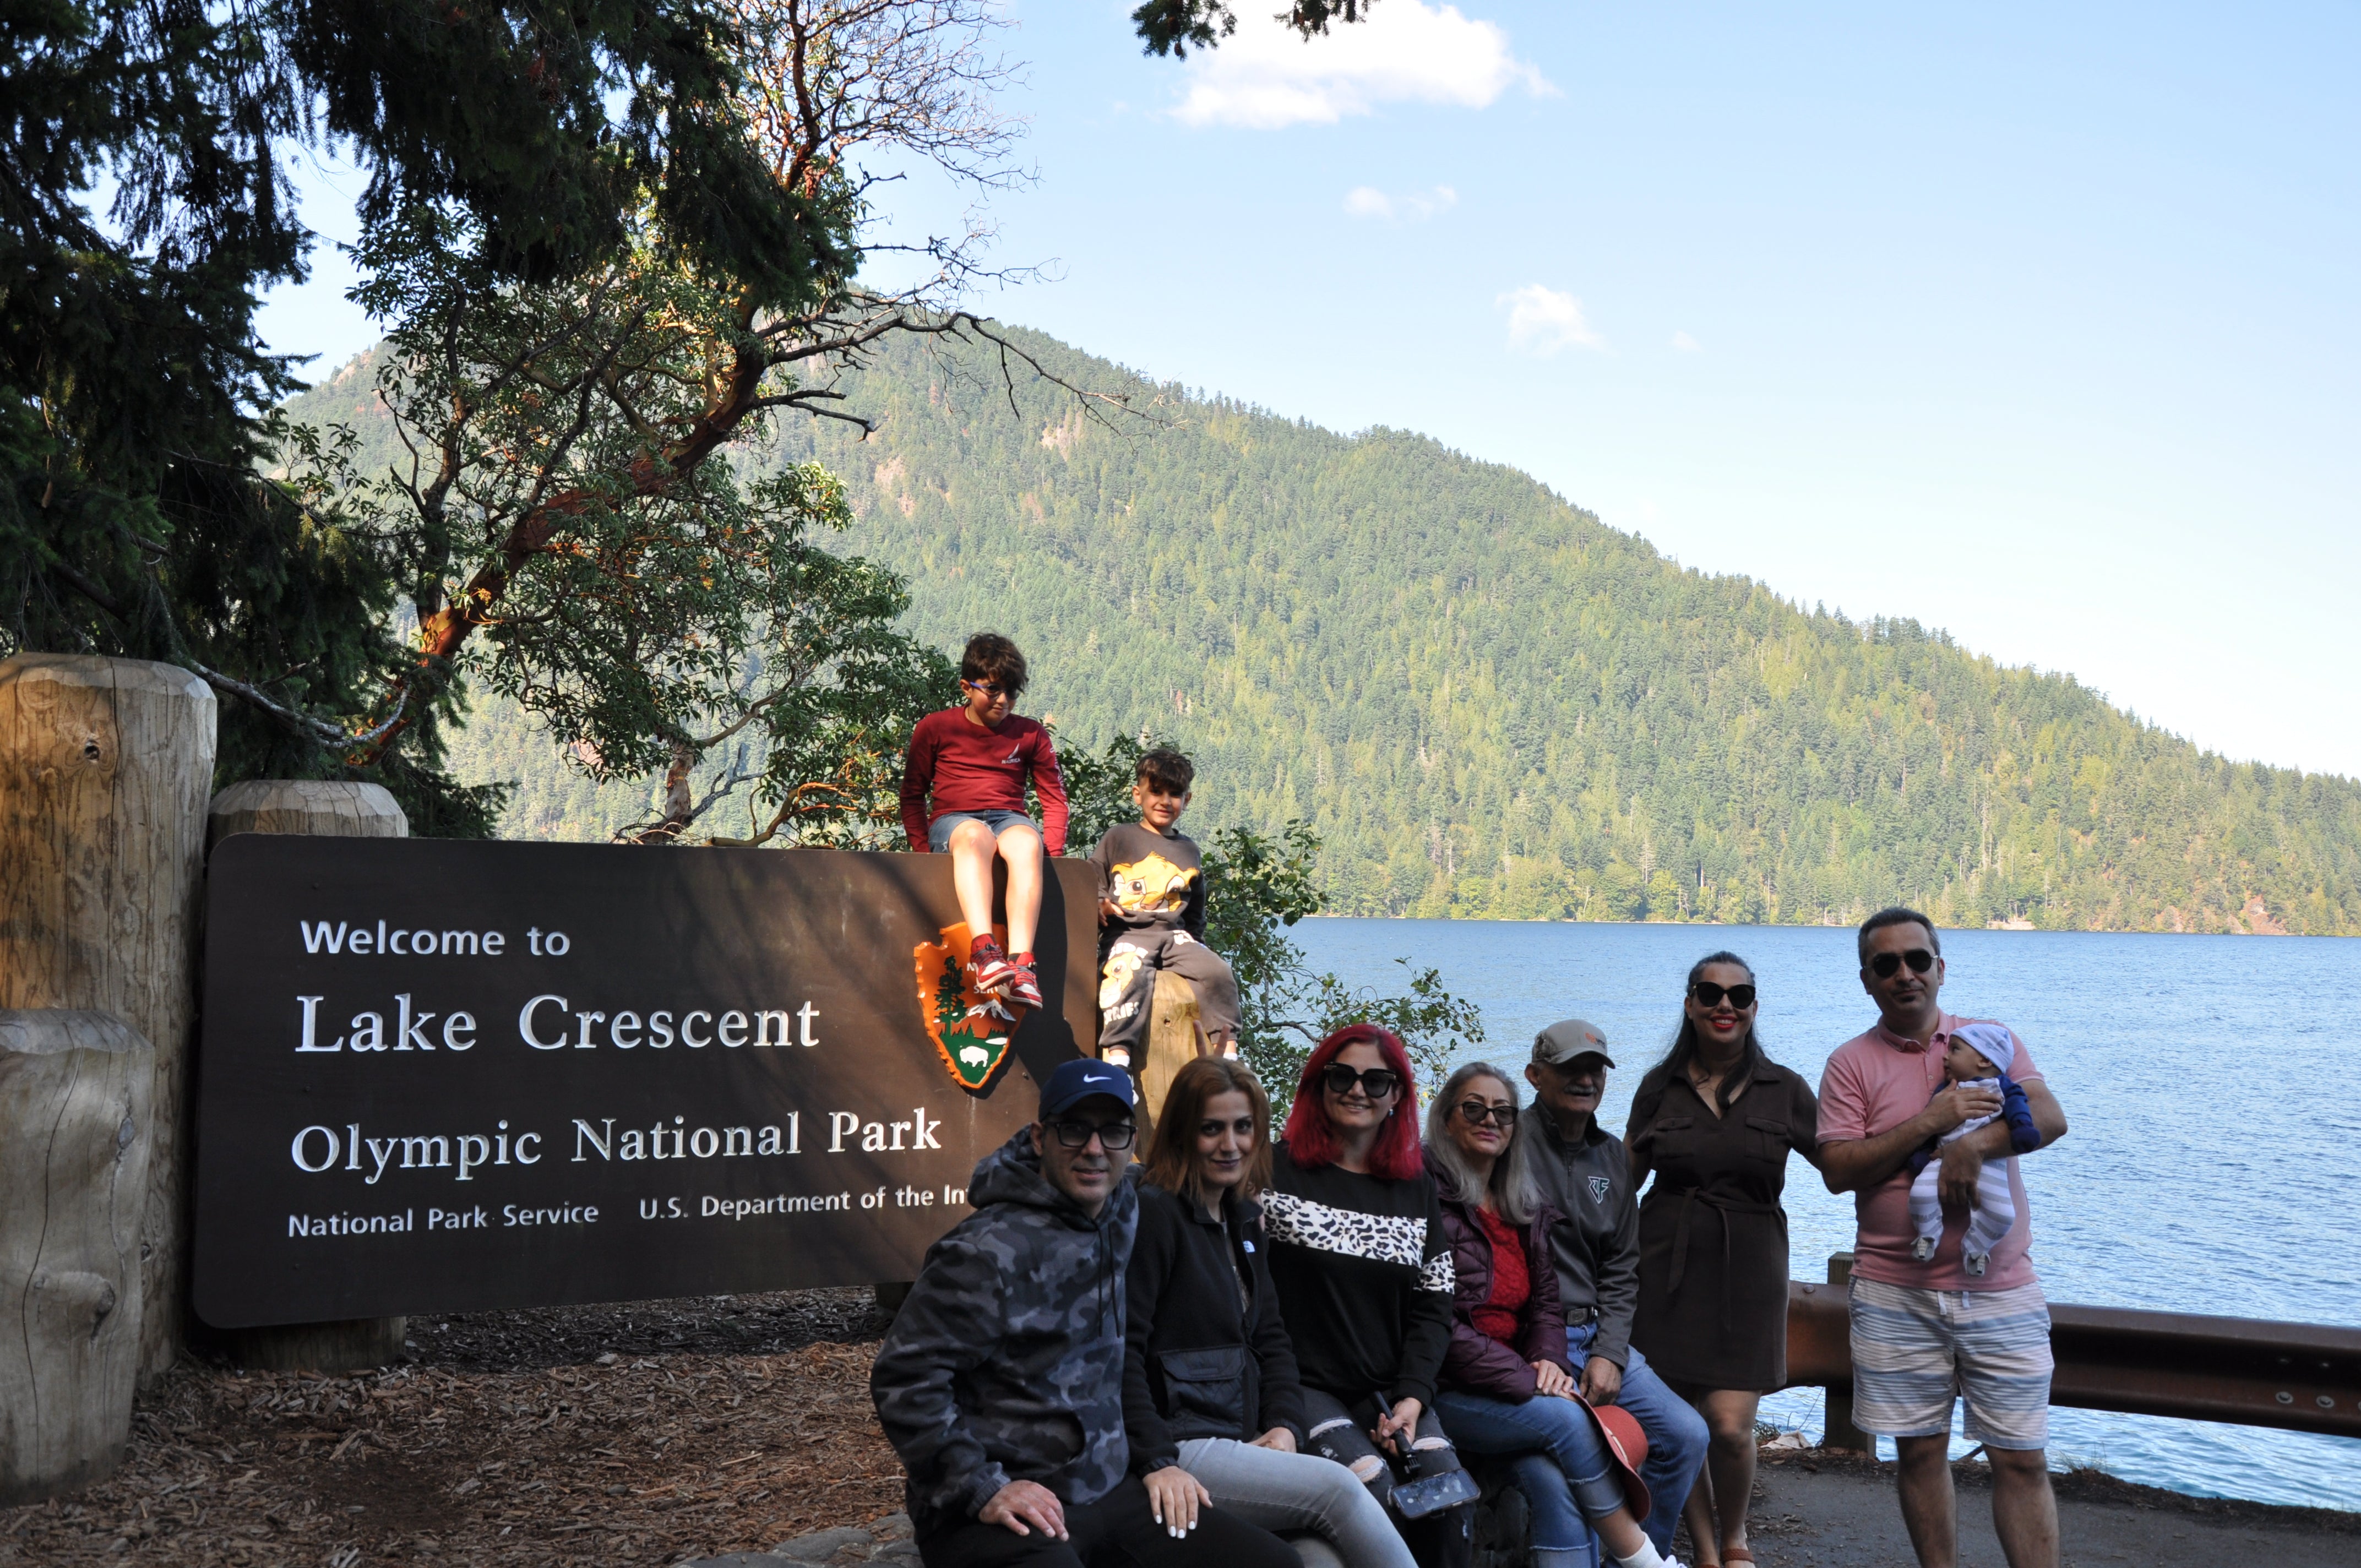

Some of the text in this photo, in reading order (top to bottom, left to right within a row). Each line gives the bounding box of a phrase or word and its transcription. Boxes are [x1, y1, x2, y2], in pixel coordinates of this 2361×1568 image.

[300, 919, 570, 956] Welcome to
[295, 993, 820, 1052] Lake Crescent
[291, 1106, 942, 1185] Olympic National Park
[289, 1201, 599, 1238] National Park Service
[640, 1184, 969, 1221] U.S. Department of the In
